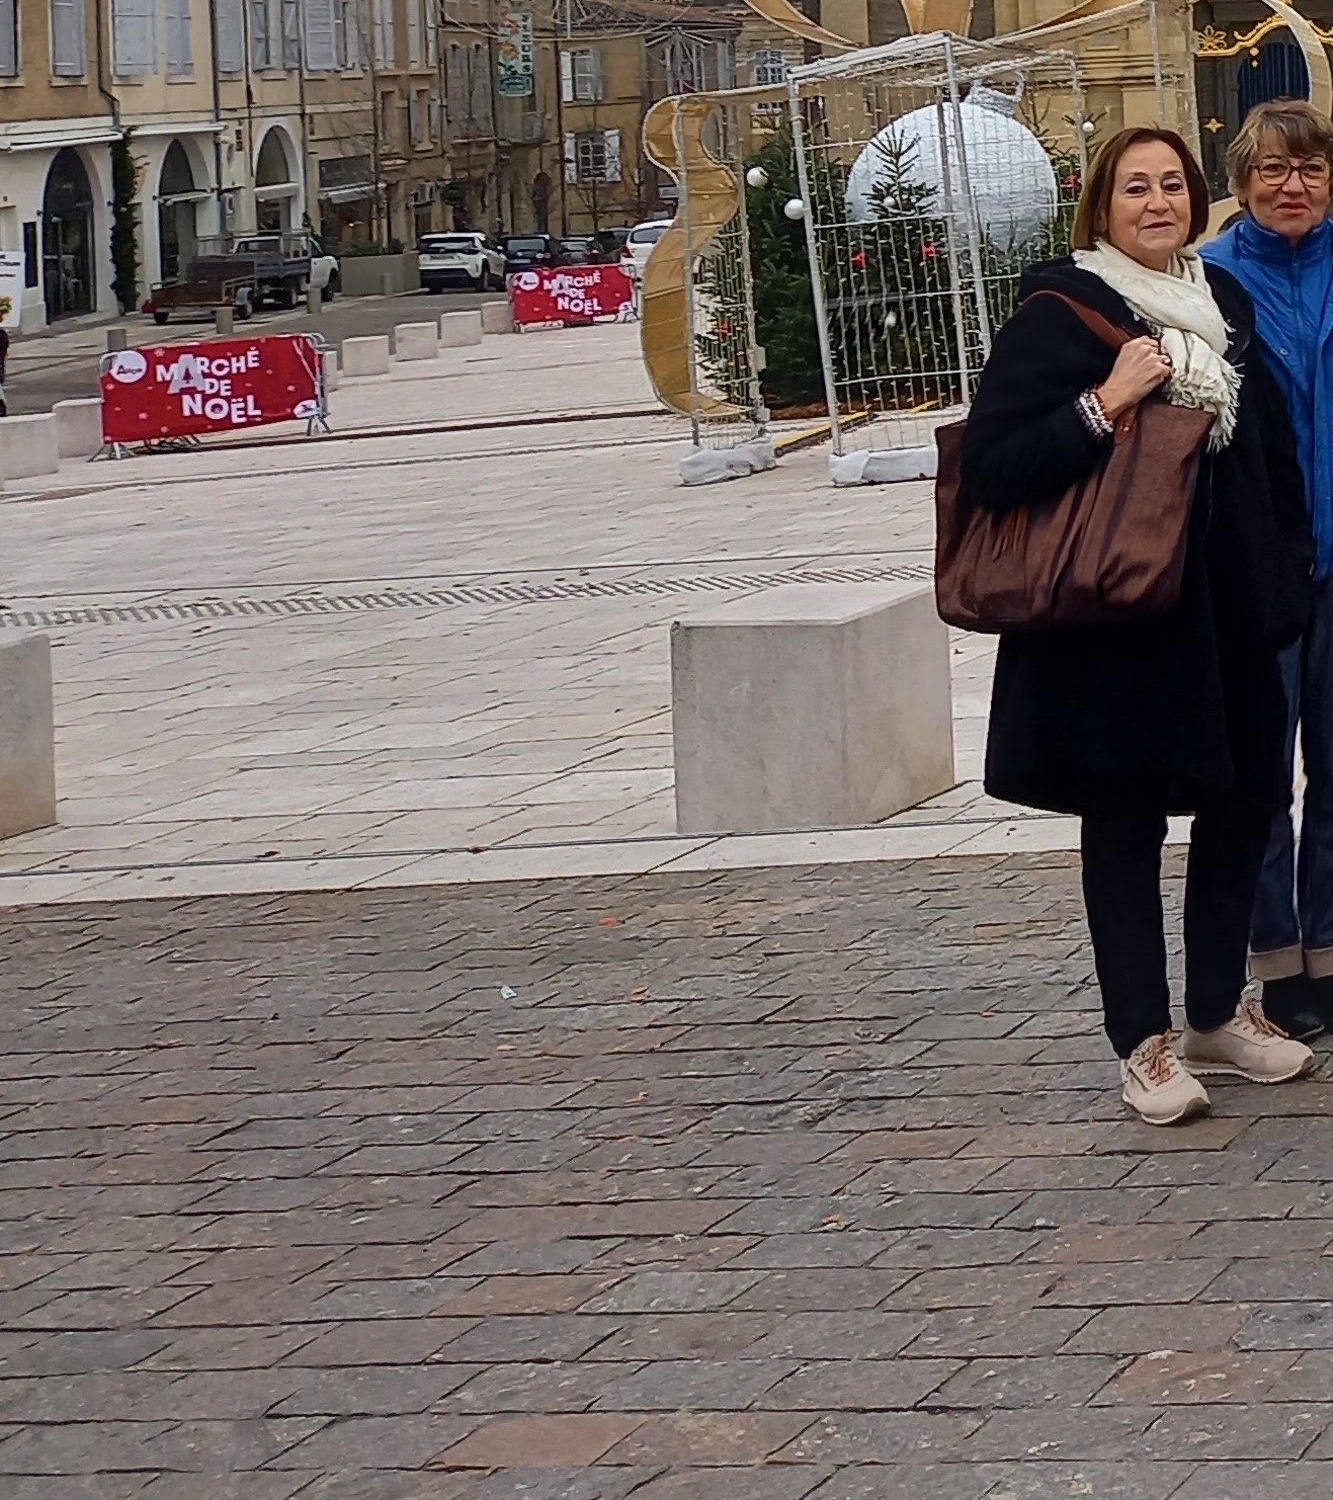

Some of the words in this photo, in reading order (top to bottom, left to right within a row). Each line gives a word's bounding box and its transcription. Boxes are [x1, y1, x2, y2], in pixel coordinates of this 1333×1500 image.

[542, 270, 601, 297] MARCHÉ
[569, 288, 585, 299] DE
[557, 296, 602, 315] NOËL
[156, 347, 260, 394] MARCHÉ
[204, 379, 232, 395] DE
[182, 395, 262, 424] NOËL
